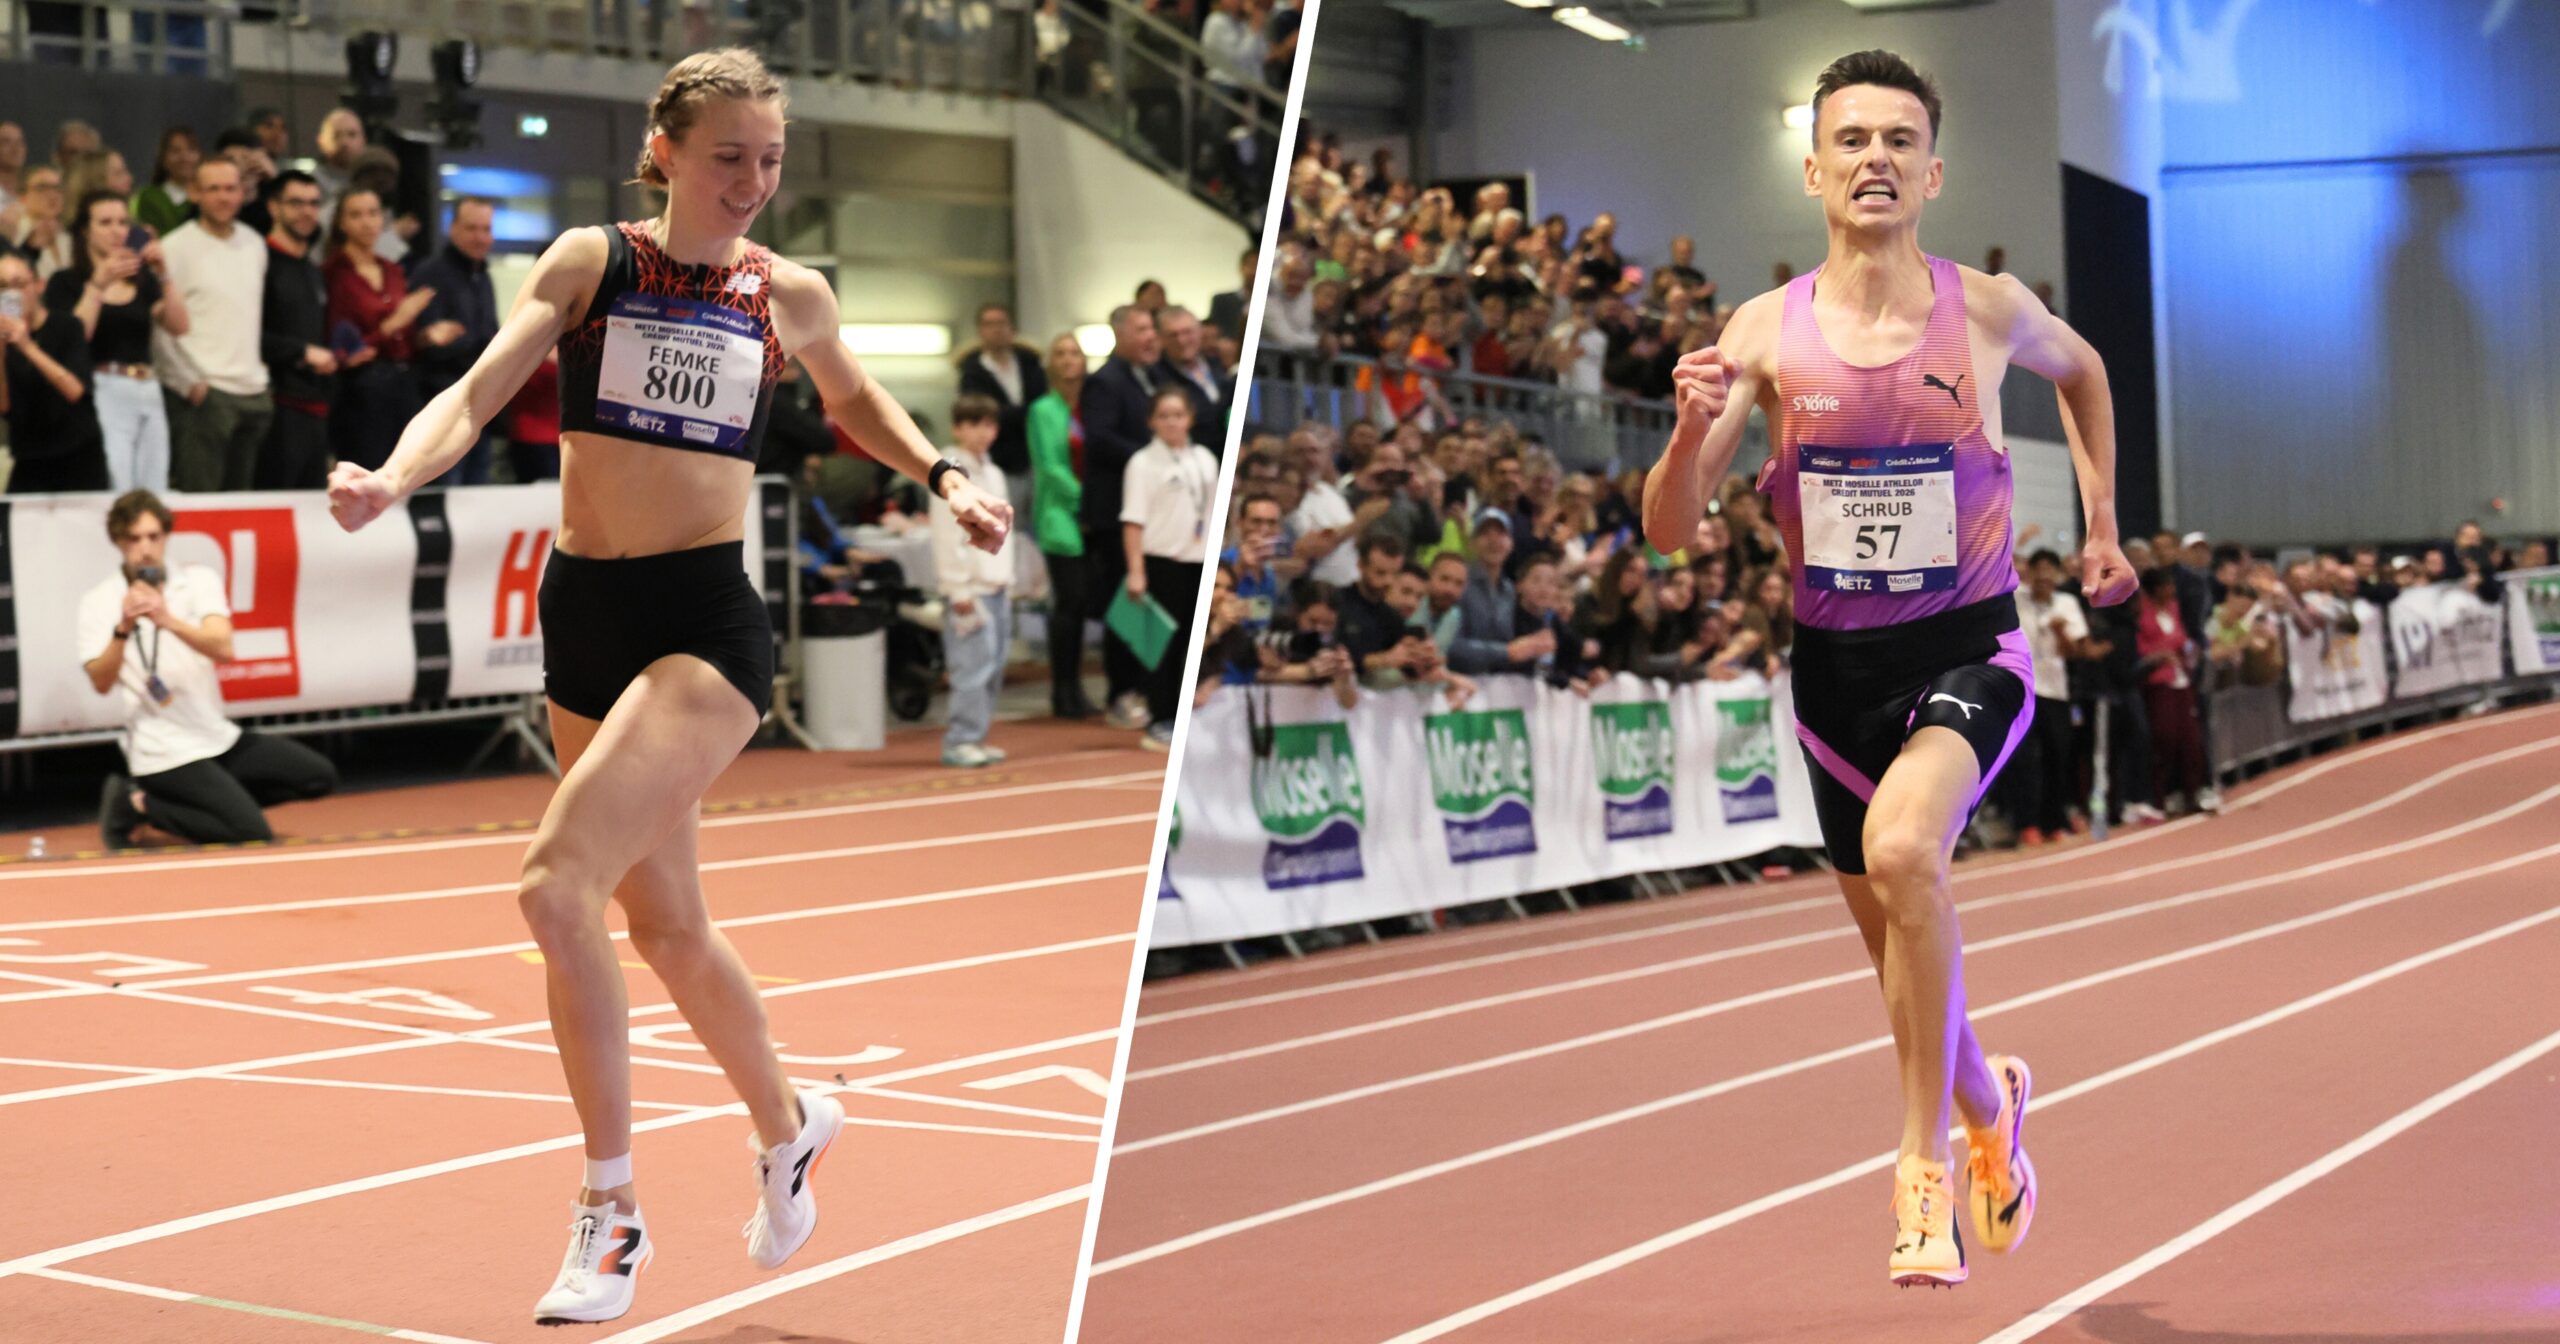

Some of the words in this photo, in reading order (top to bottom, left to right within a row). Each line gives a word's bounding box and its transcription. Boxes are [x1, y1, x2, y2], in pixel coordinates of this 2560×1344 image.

[634, 323, 656, 332] METZ
[659, 326, 695, 337] MOSELLE
[673, 336, 703, 347] MUTUEL
[706, 342, 726, 351] 2026
[648, 345, 722, 375] FEMKE
[643, 365, 716, 409] 800
[1823, 479, 1843, 487] METZ
[1845, 479, 1881, 488] MOSELLE
[1883, 478, 1924, 487] ATHLELOR
[1860, 489, 1892, 498] MUTUEL
[1895, 488, 1916, 497] 2026
[1842, 501, 1913, 518] SCHRUB
[1855, 524, 1902, 560] 57
[1836, 577, 1873, 591] METZ
[1888, 574, 1922, 585] Moselle
[1426, 716, 1531, 799] Moselle
